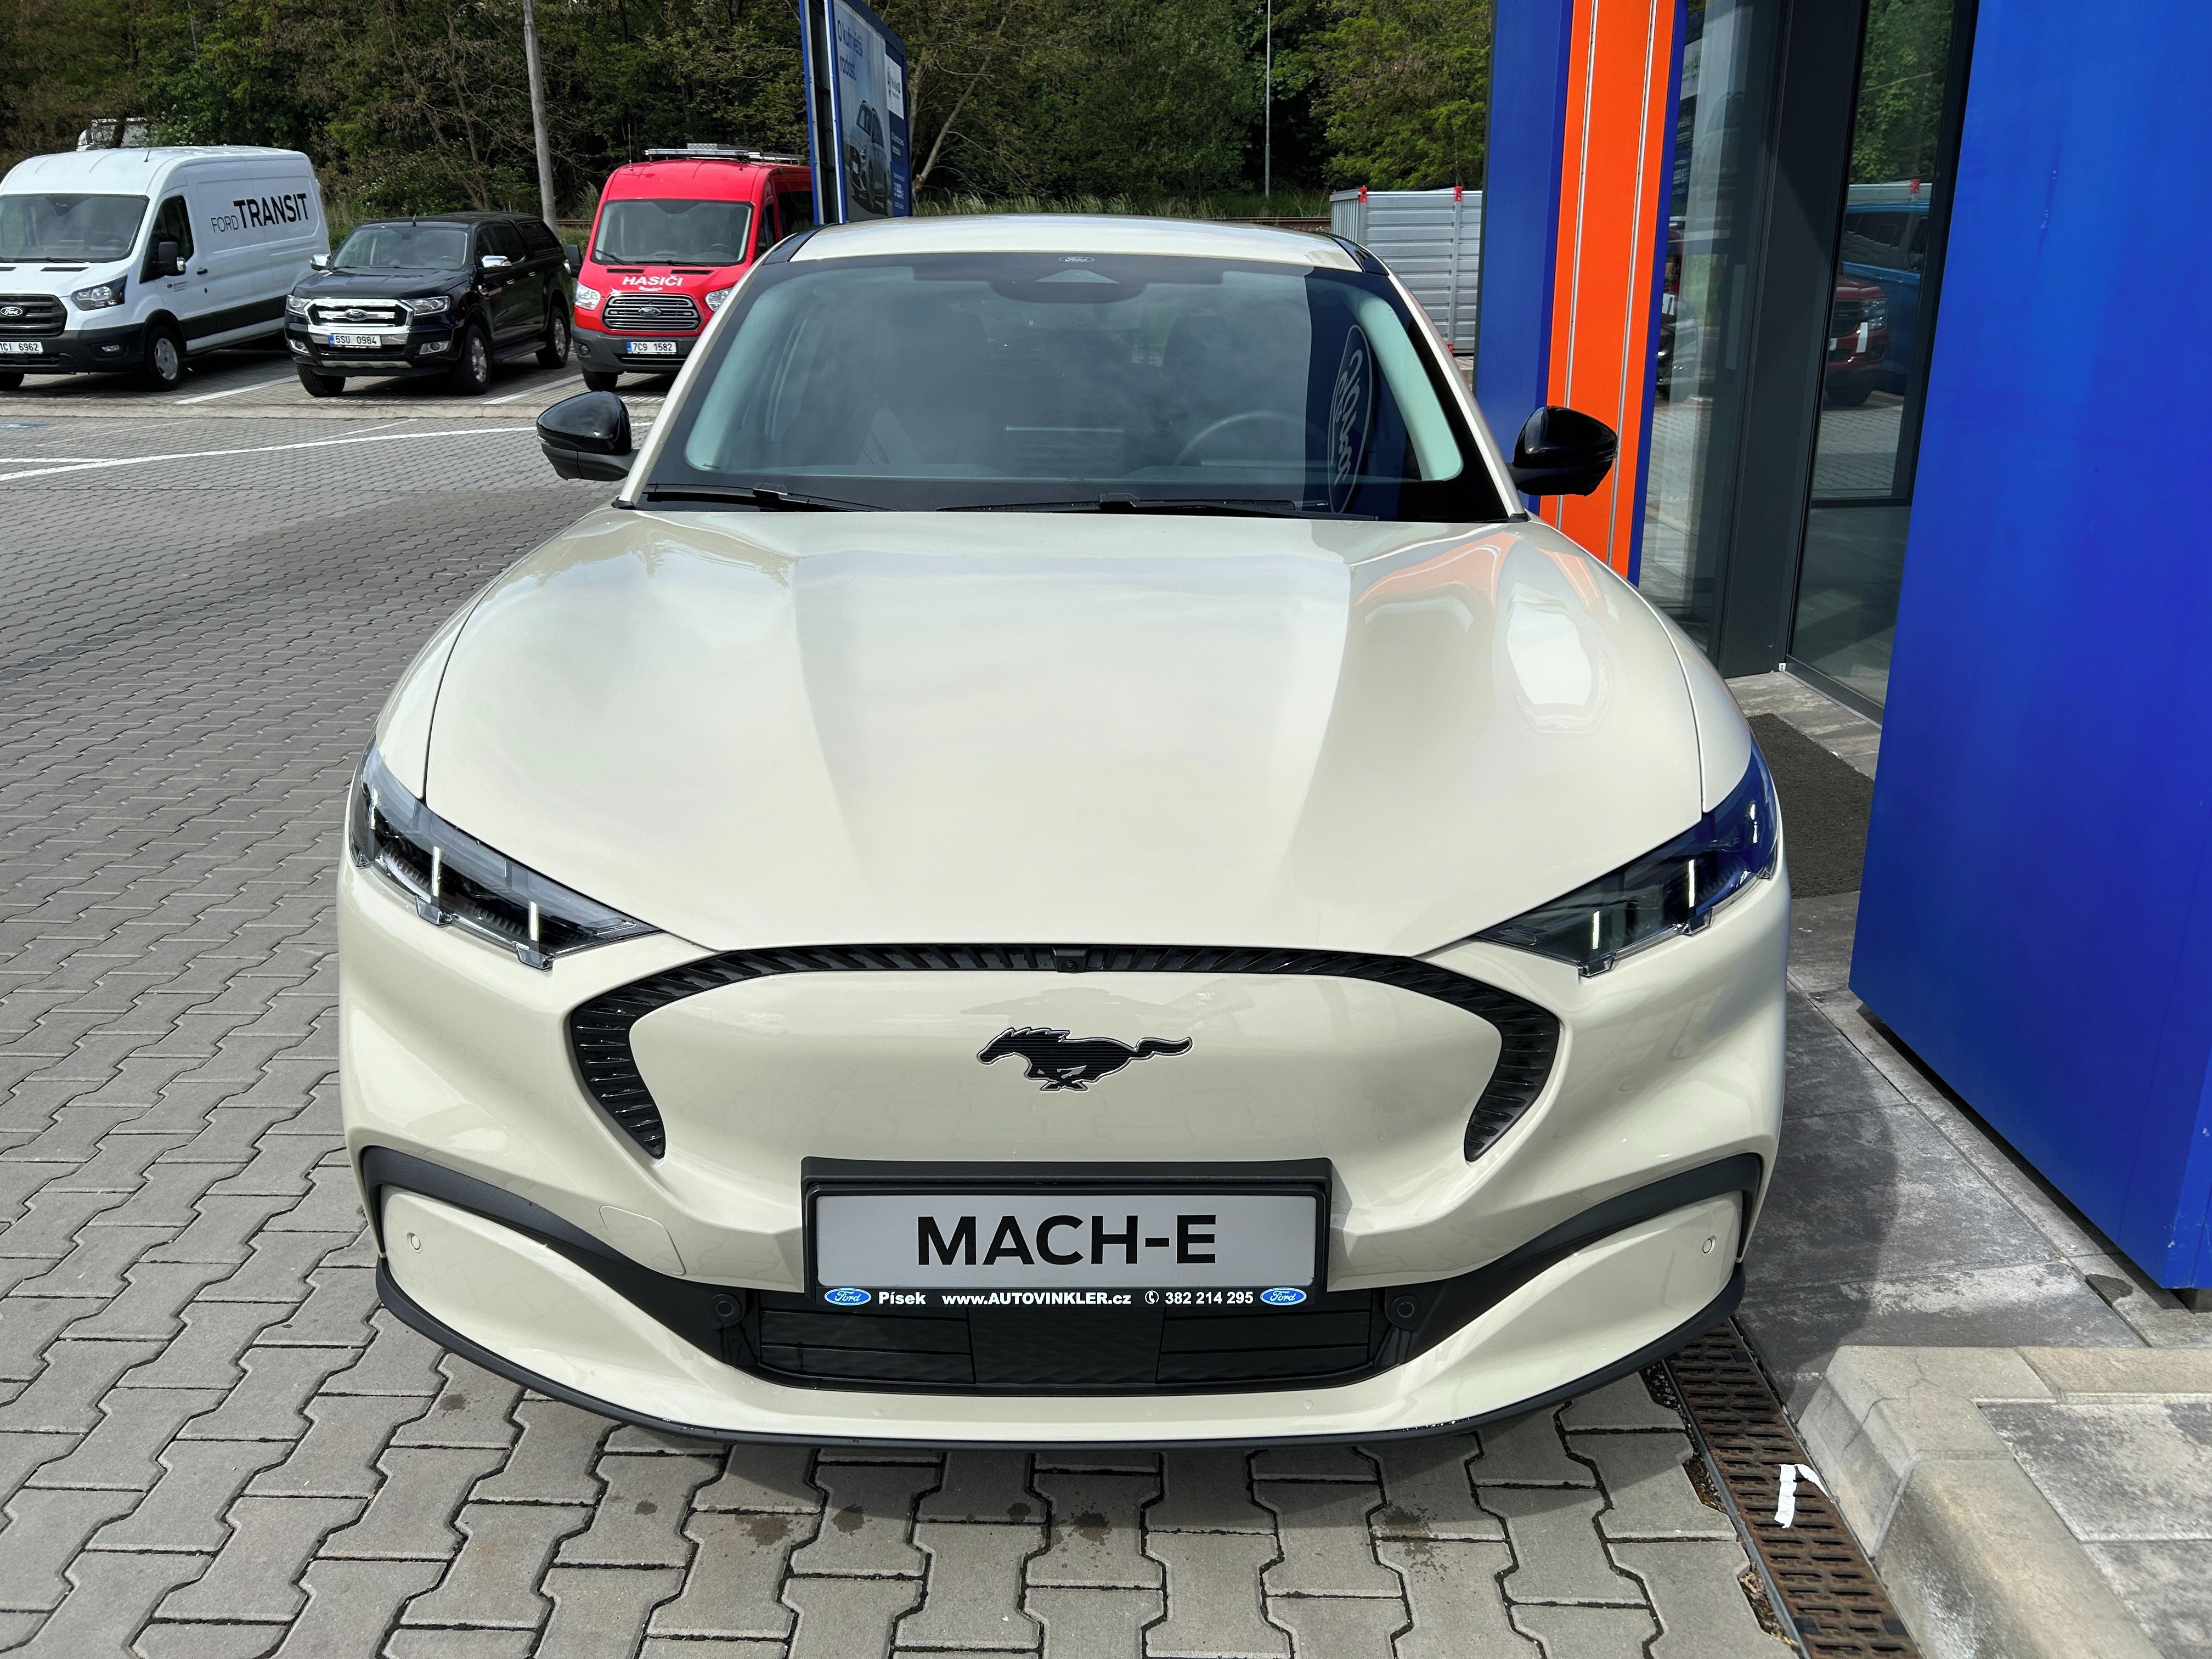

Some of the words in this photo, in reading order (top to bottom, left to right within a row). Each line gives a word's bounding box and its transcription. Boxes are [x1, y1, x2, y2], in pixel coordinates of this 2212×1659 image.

[211, 215, 239, 233] FORD
[233, 193, 308, 229] TRANSIT
[622, 275, 684, 286] HASIČI
[335, 335, 351, 344] 5SU
[357, 336, 377, 345] 0984
[18, 343, 39, 351] 6962
[633, 343, 647, 351] 7C9
[653, 343, 673, 351] 1582
[917, 1215, 1216, 1266] MACH-E
[878, 1291, 927, 1305] Písek
[941, 1292, 1132, 1305] www.AUTOVINKLER.cz
[1165, 1291, 1192, 1304] 382
[1195, 1291, 1223, 1304] 214
[1227, 1291, 1254, 1304] 295
